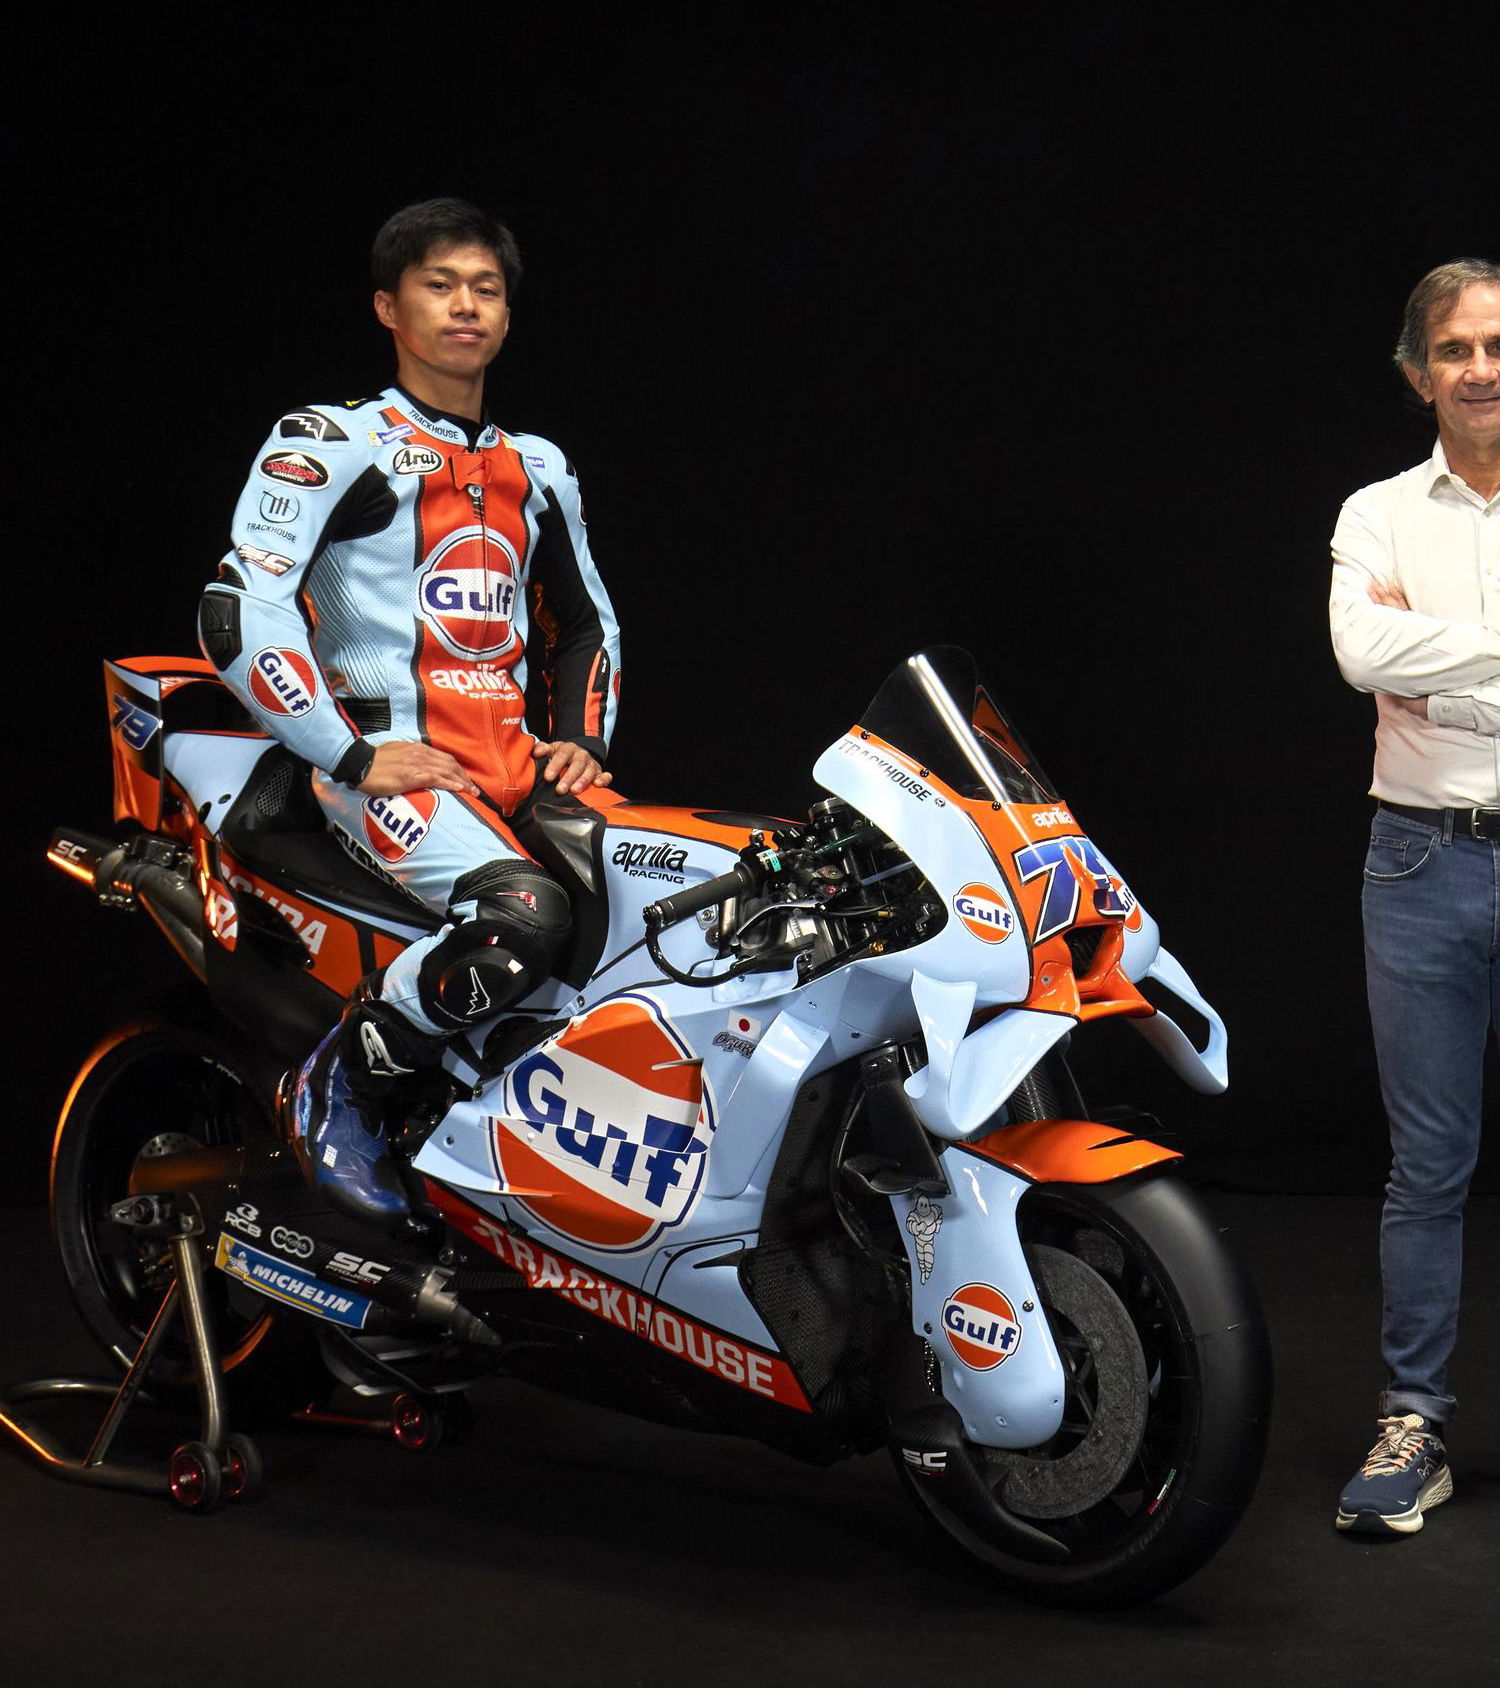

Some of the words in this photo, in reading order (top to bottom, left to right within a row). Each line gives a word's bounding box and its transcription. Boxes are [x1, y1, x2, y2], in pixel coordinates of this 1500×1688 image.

[408, 409, 460, 440] TRACKHOUSE
[400, 449, 436, 466] Arai
[246, 522, 297, 544] TRACKHOUSE
[425, 576, 514, 615] Gulf
[259, 652, 310, 712] Gulf
[367, 795, 424, 848] Gulf
[1031, 807, 1075, 828] aprilia
[54, 839, 88, 861] SC
[612, 841, 689, 874] aprilia
[629, 869, 686, 885] RACING
[955, 896, 1012, 931] Gulf
[513, 1051, 708, 1208] Gulf
[225, 1211, 262, 1239] RCB
[325, 1251, 392, 1282] SC
[325, 1264, 382, 1285] PROJECT
[252, 1264, 354, 1313] MICHELIN
[474, 1217, 775, 1398] TRACKHOUSE
[944, 1303, 1018, 1352] Gulf
[902, 1448, 947, 1468] SC
